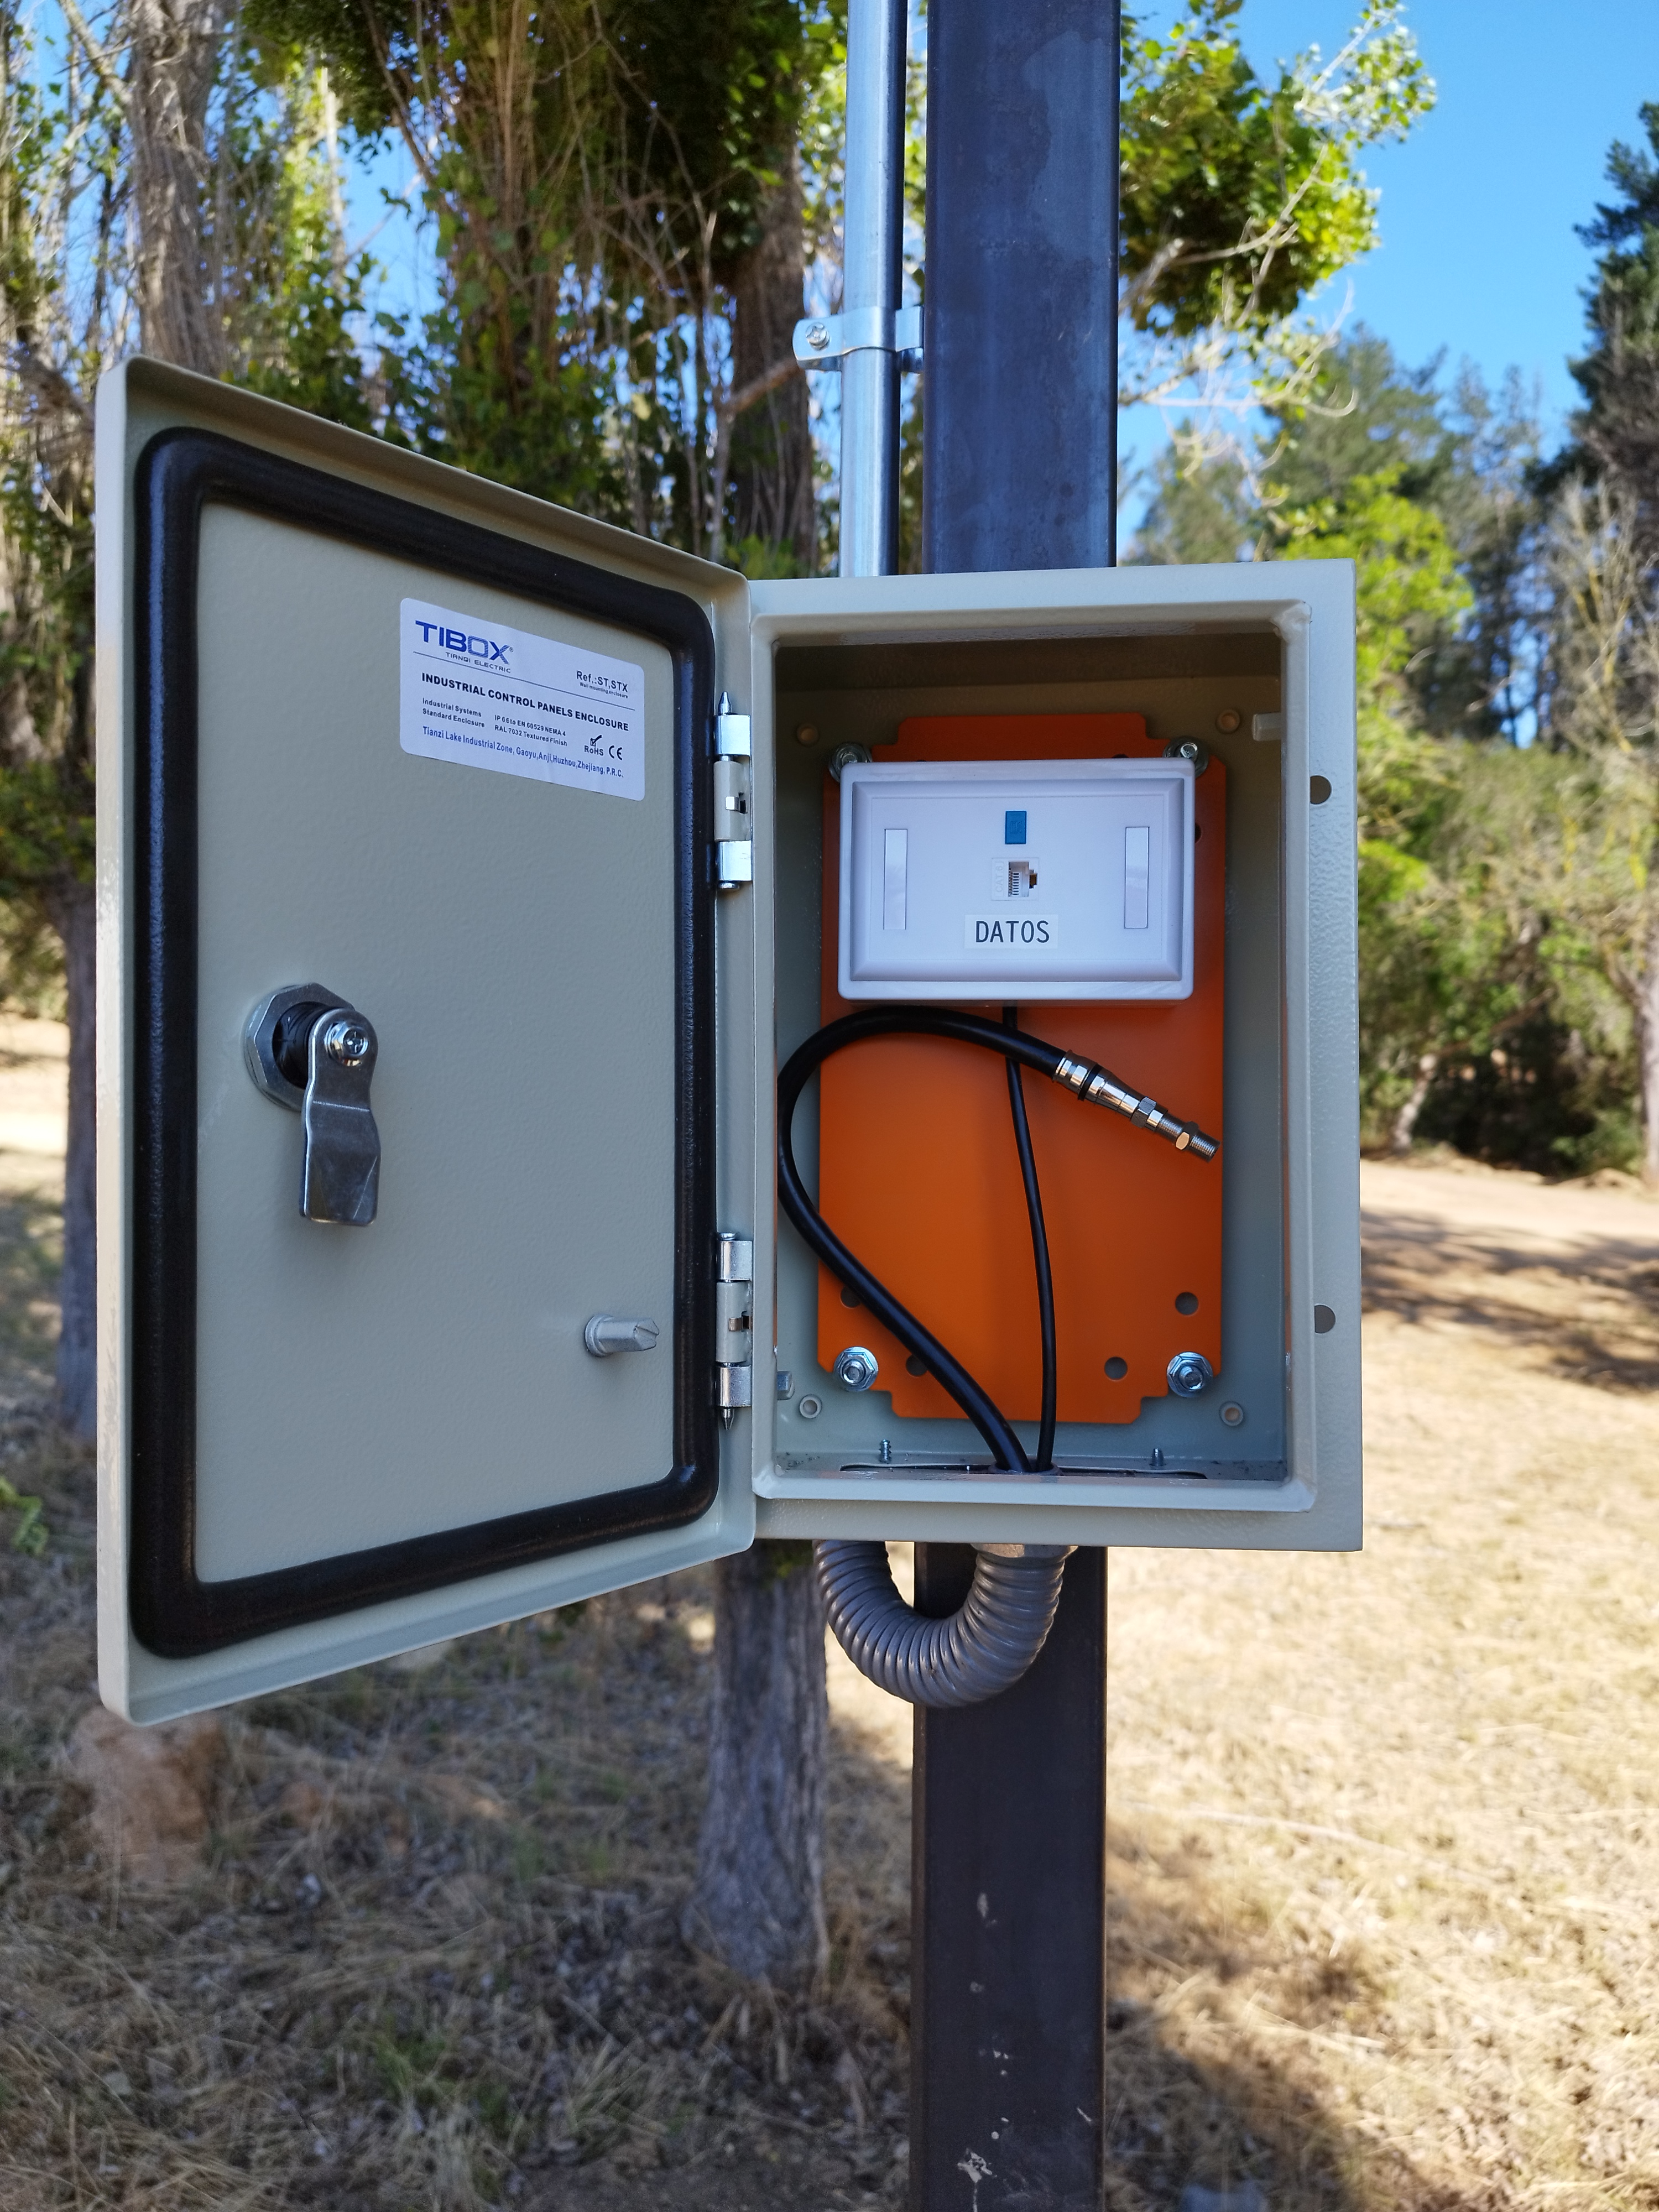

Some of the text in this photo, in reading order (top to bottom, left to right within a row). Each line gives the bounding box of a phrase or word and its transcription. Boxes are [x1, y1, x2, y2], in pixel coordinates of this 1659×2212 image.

[415, 620, 509, 665] TIBOX
[474, 660, 511, 674] ELECTRIC
[422, 672, 629, 731] INDUSTRIAL CONTROL PANELS ENCLOSURE
[589, 685, 608, 694] mounting
[609, 690, 628, 698] enclosure
[422, 697, 482, 717] Industrial Systems
[422, 708, 485, 728] Standard Enclosure
[494, 725, 567, 747] RAL 7032 Textured Finish
[526, 722, 544, 731] 60529
[545, 727, 562, 736] NEMA
[422, 726, 444, 738] Tianzi
[445, 731, 461, 742] Lake
[463, 735, 495, 750] Industrial
[497, 743, 515, 755] Zone,
[584, 745, 604, 756] RoHS
[975, 920, 1050, 943] DATOS
